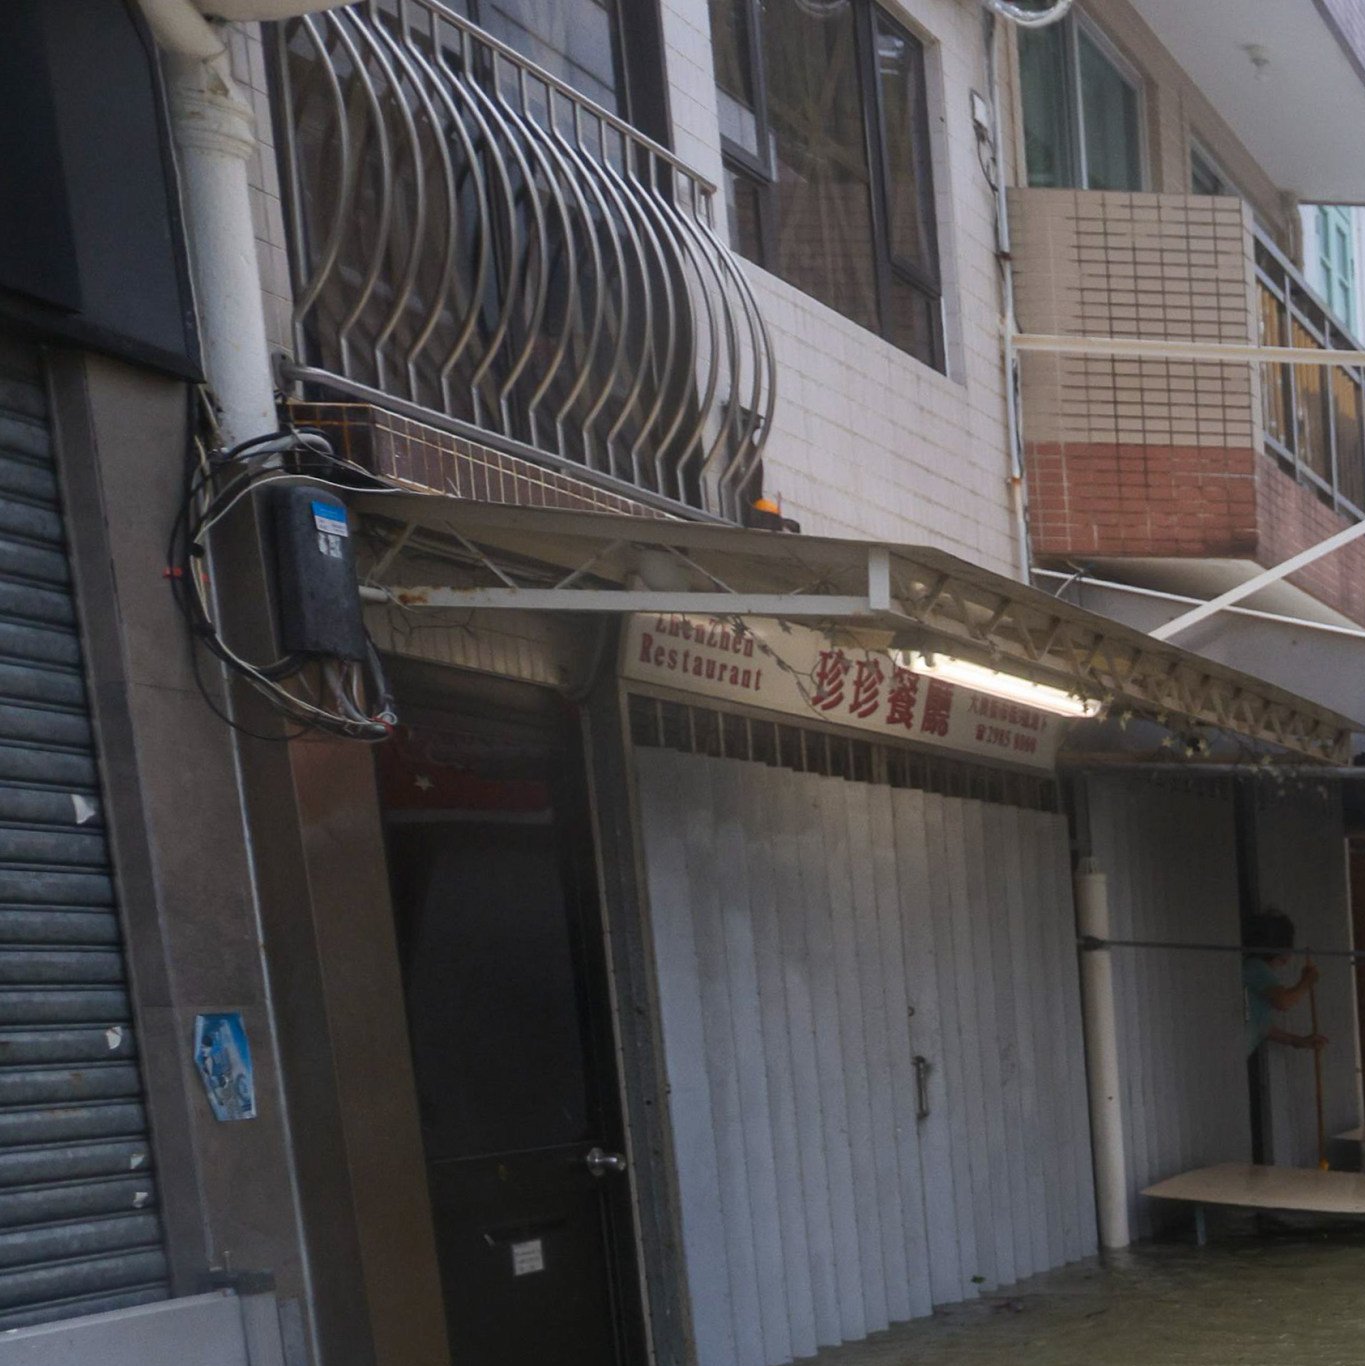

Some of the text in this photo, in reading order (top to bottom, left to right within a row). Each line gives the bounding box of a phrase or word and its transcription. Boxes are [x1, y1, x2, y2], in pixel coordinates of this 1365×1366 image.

[639, 632, 763, 691] Restaurant
[811, 648, 954, 738] 珍珍餐廳
